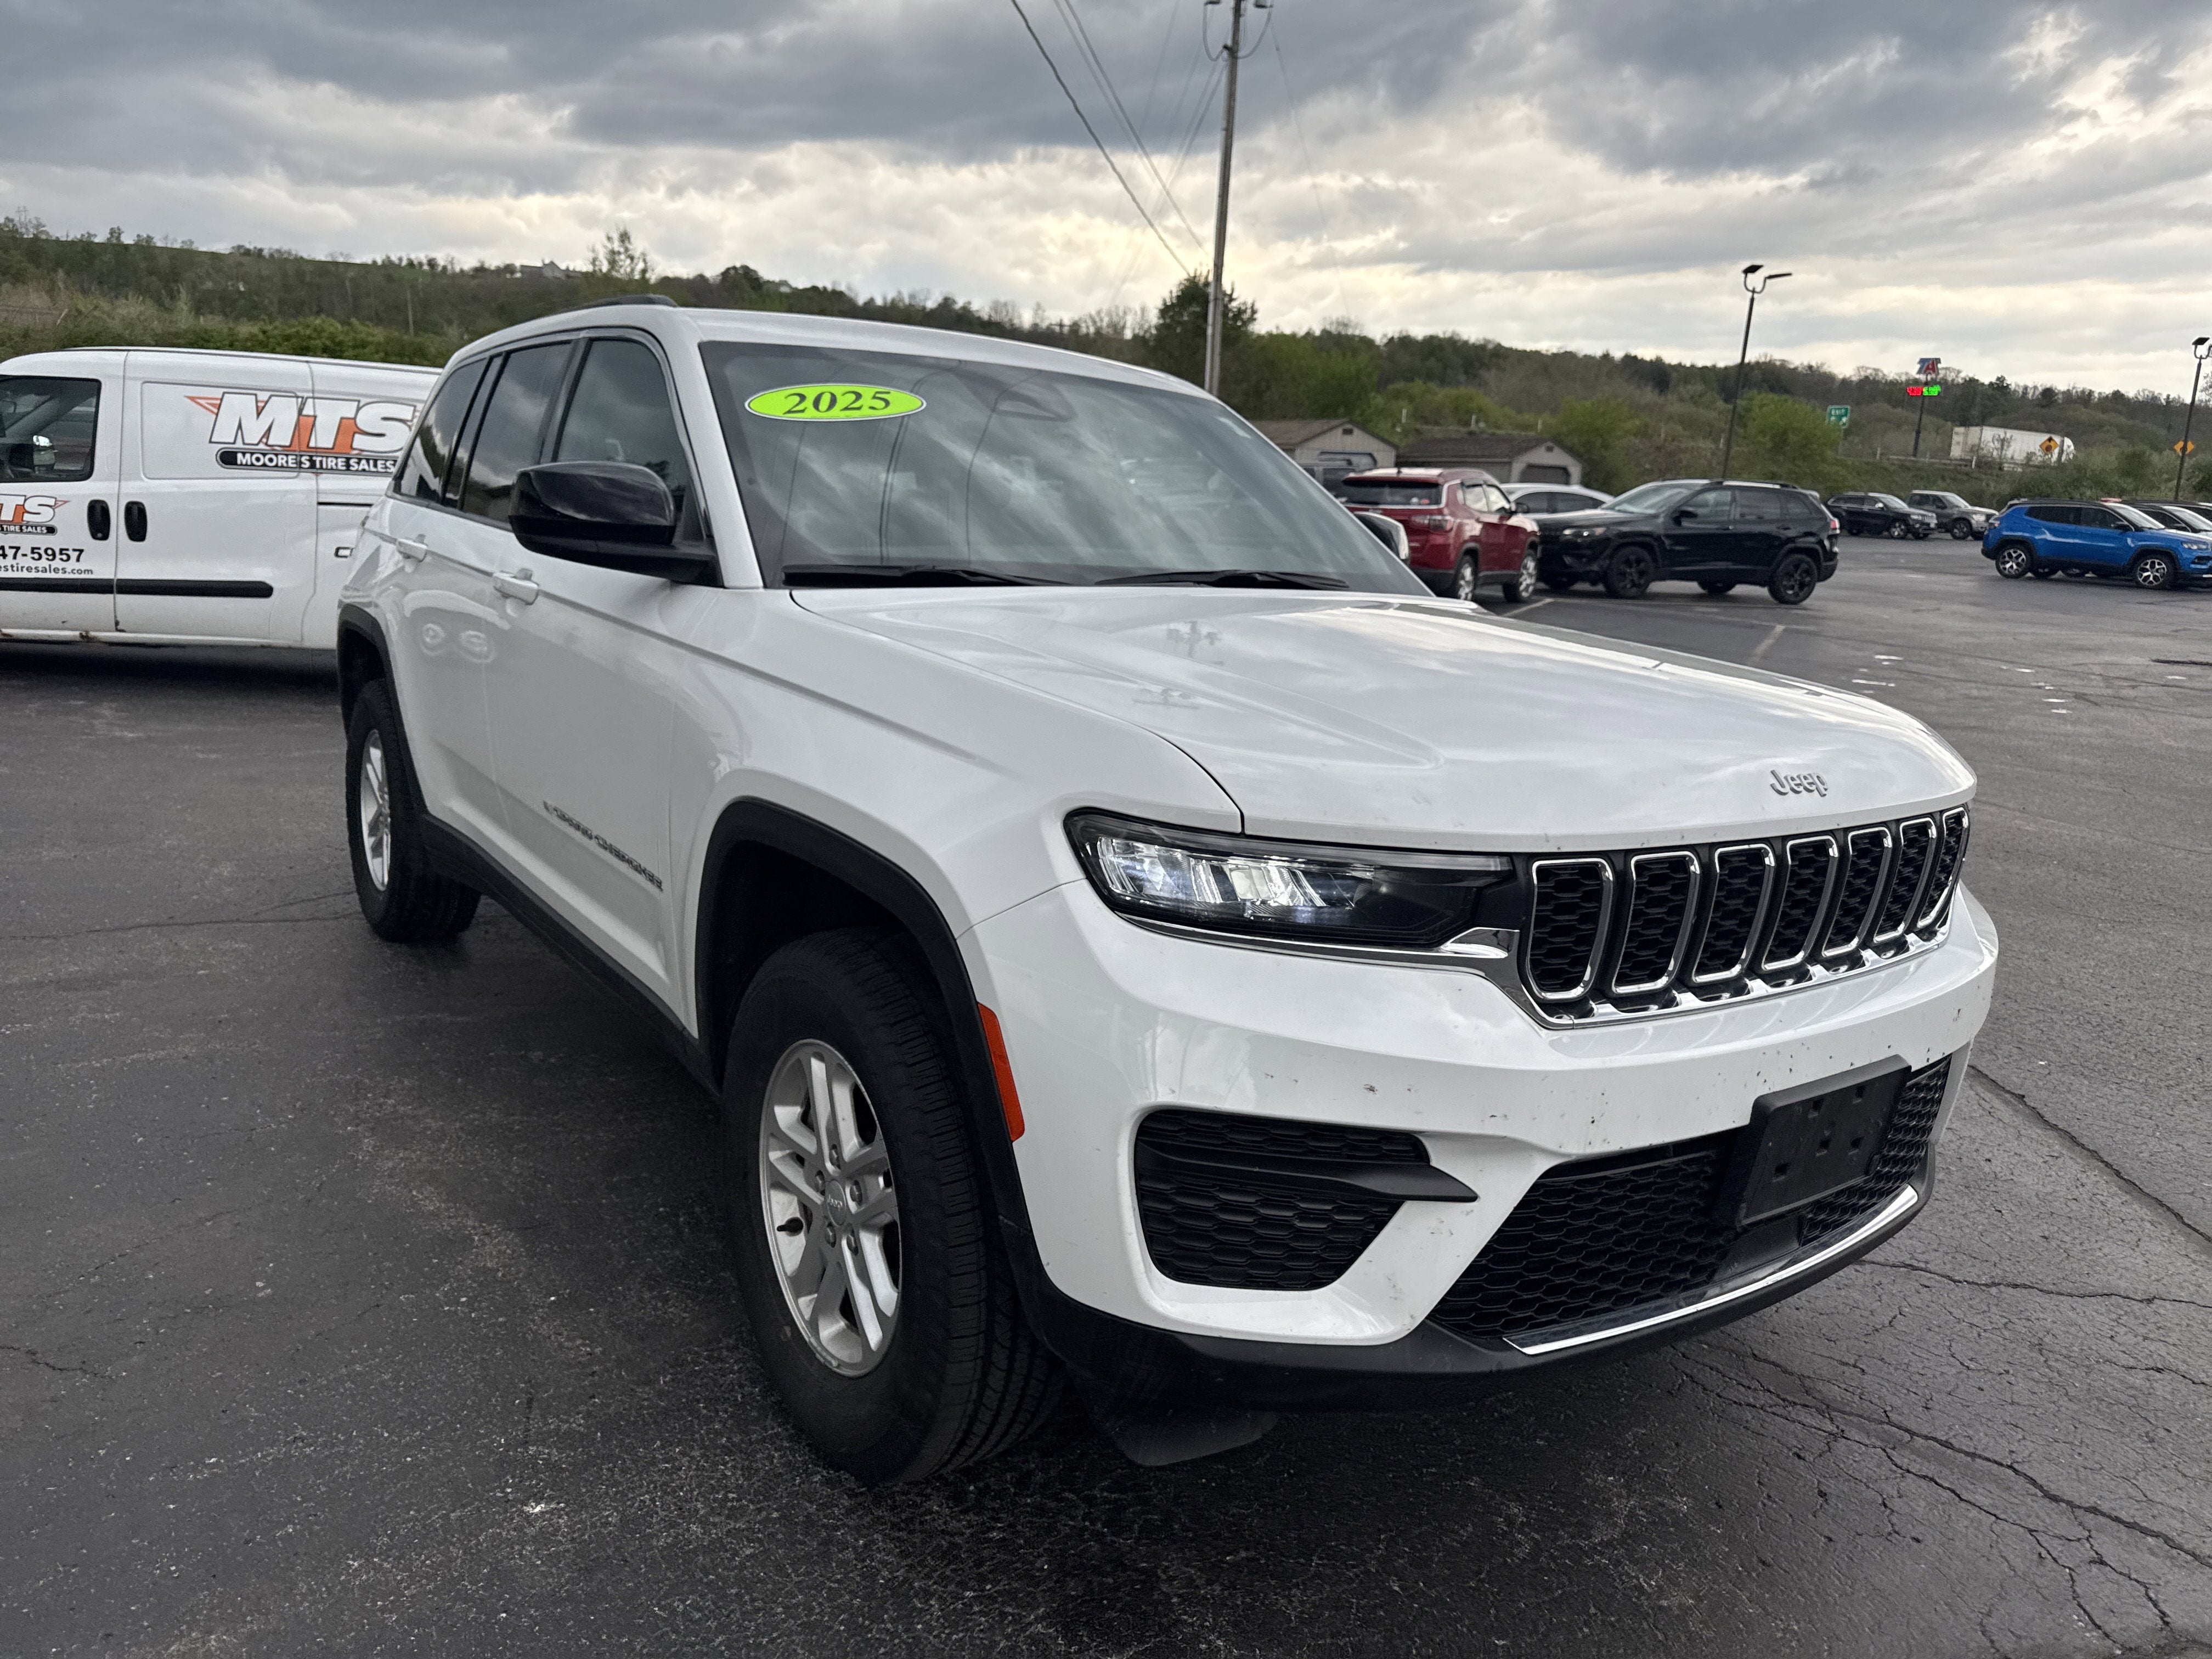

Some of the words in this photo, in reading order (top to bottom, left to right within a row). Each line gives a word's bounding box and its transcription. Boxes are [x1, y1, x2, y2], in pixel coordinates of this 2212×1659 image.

[782, 391, 891, 415] 2025
[209, 391, 417, 453] MTS
[236, 452, 311, 469] MOORES
[312, 456, 347, 470] TIRE
[349, 458, 394, 473] SALES
[22, 526, 48, 534] SALES
[0, 545, 84, 563] 47-5957
[1770, 769, 1829, 798] Jeep
